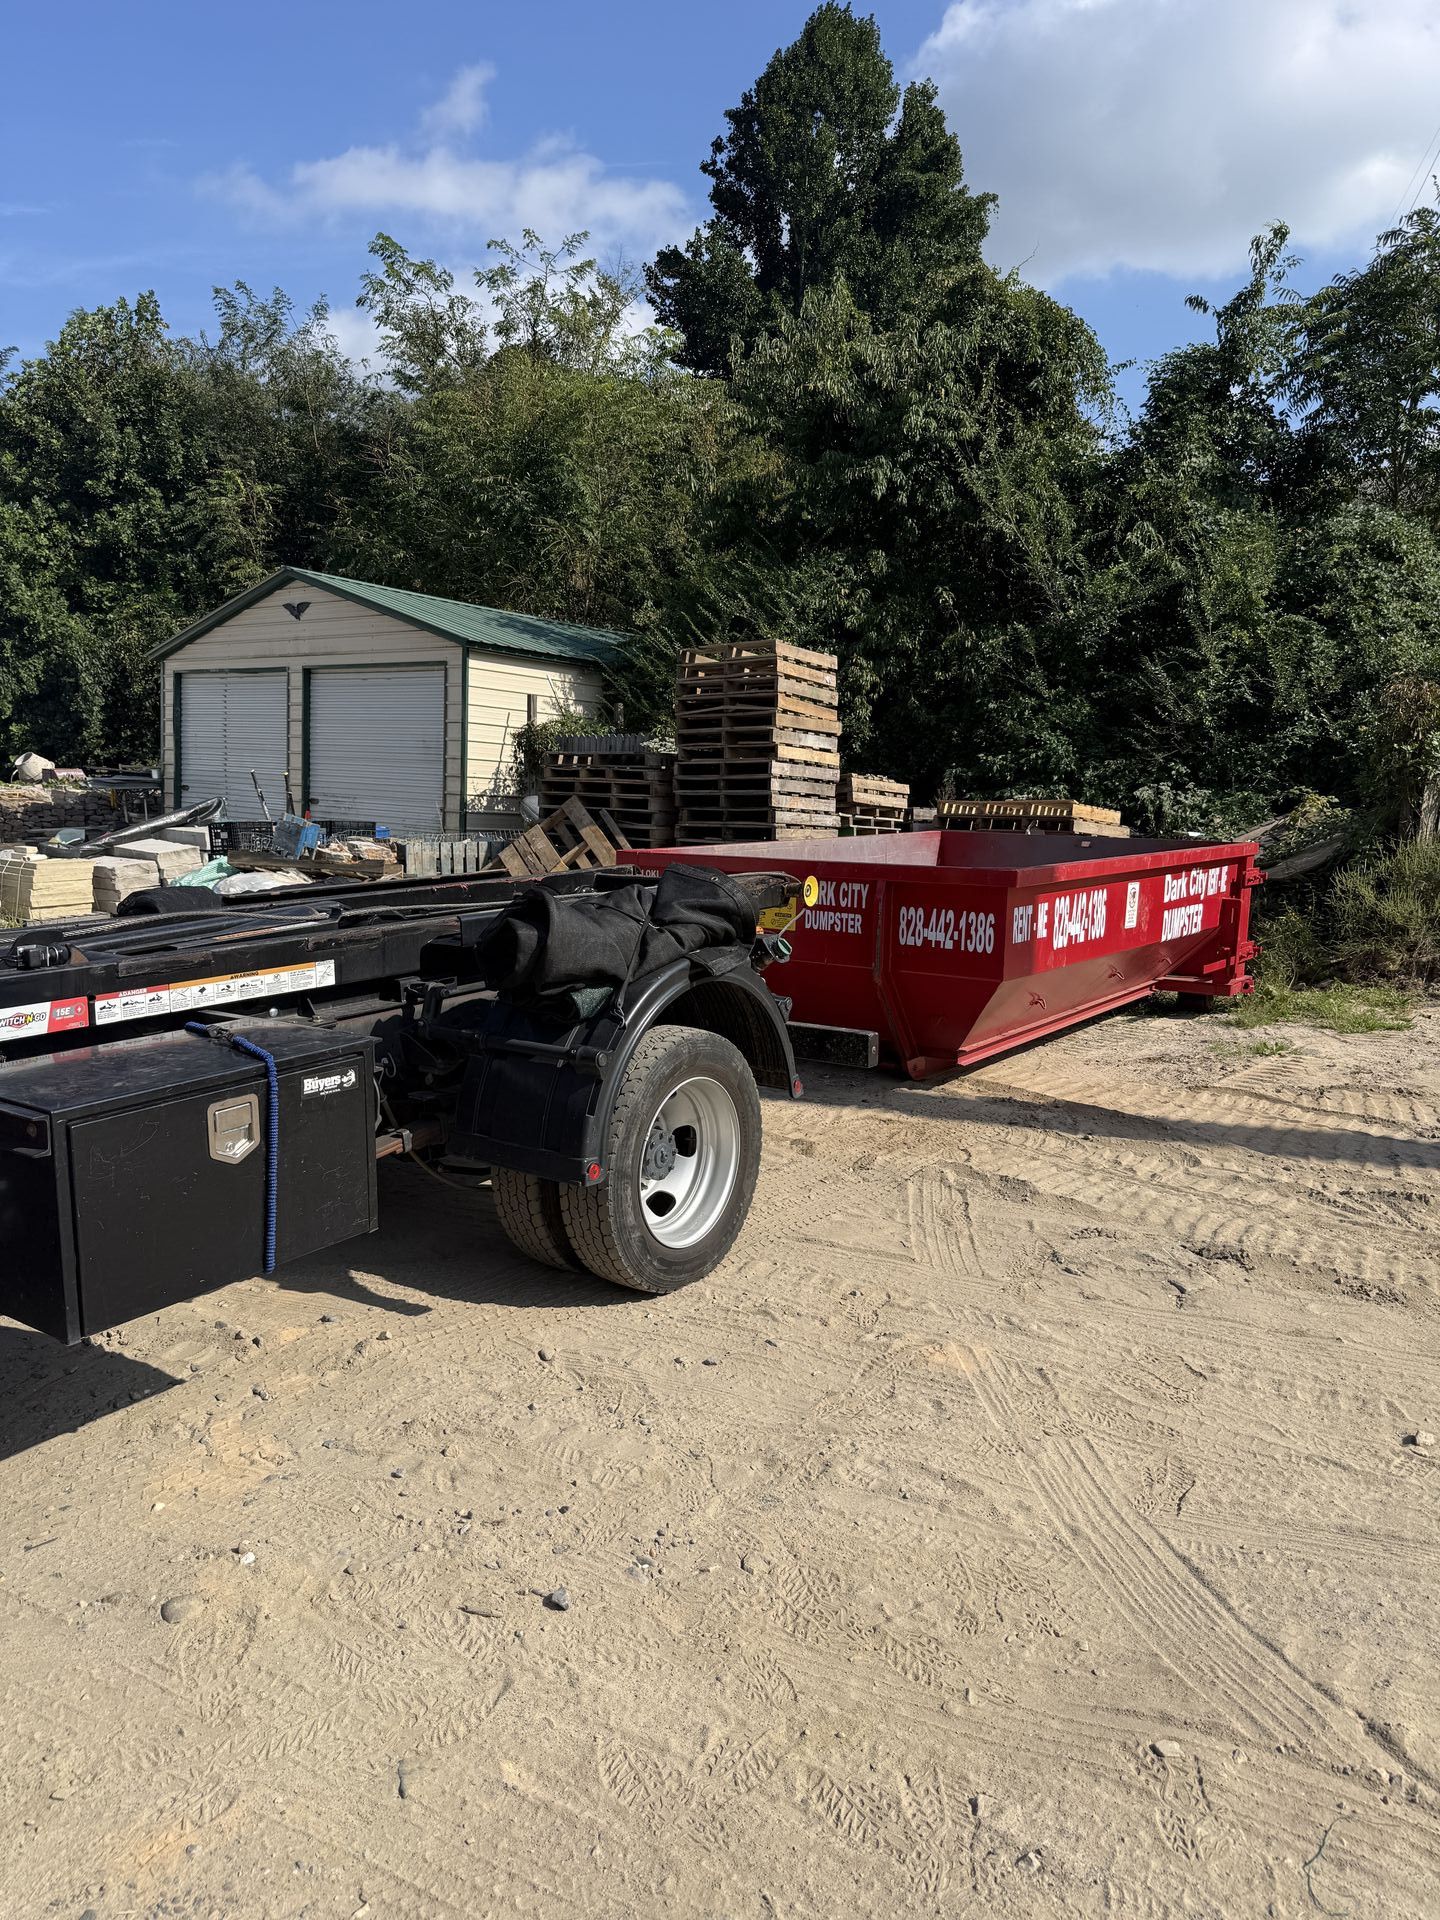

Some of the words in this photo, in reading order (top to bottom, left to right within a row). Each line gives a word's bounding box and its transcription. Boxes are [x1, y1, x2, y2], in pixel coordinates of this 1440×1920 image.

[840, 881, 869, 909] CITY
[1163, 871, 1188, 903] Dark
[1189, 867, 1208, 901] City
[805, 909, 862, 935] DUMPSTER
[899, 906, 995, 954] 828-442-1386
[1012, 904, 1033, 944] RENT
[1037, 902, 1049, 939] ME
[1053, 888, 1107, 950] 828-442-1386
[1160, 903, 1204, 943] DUMPSTER
[304, 1075, 341, 1092] Buyers
